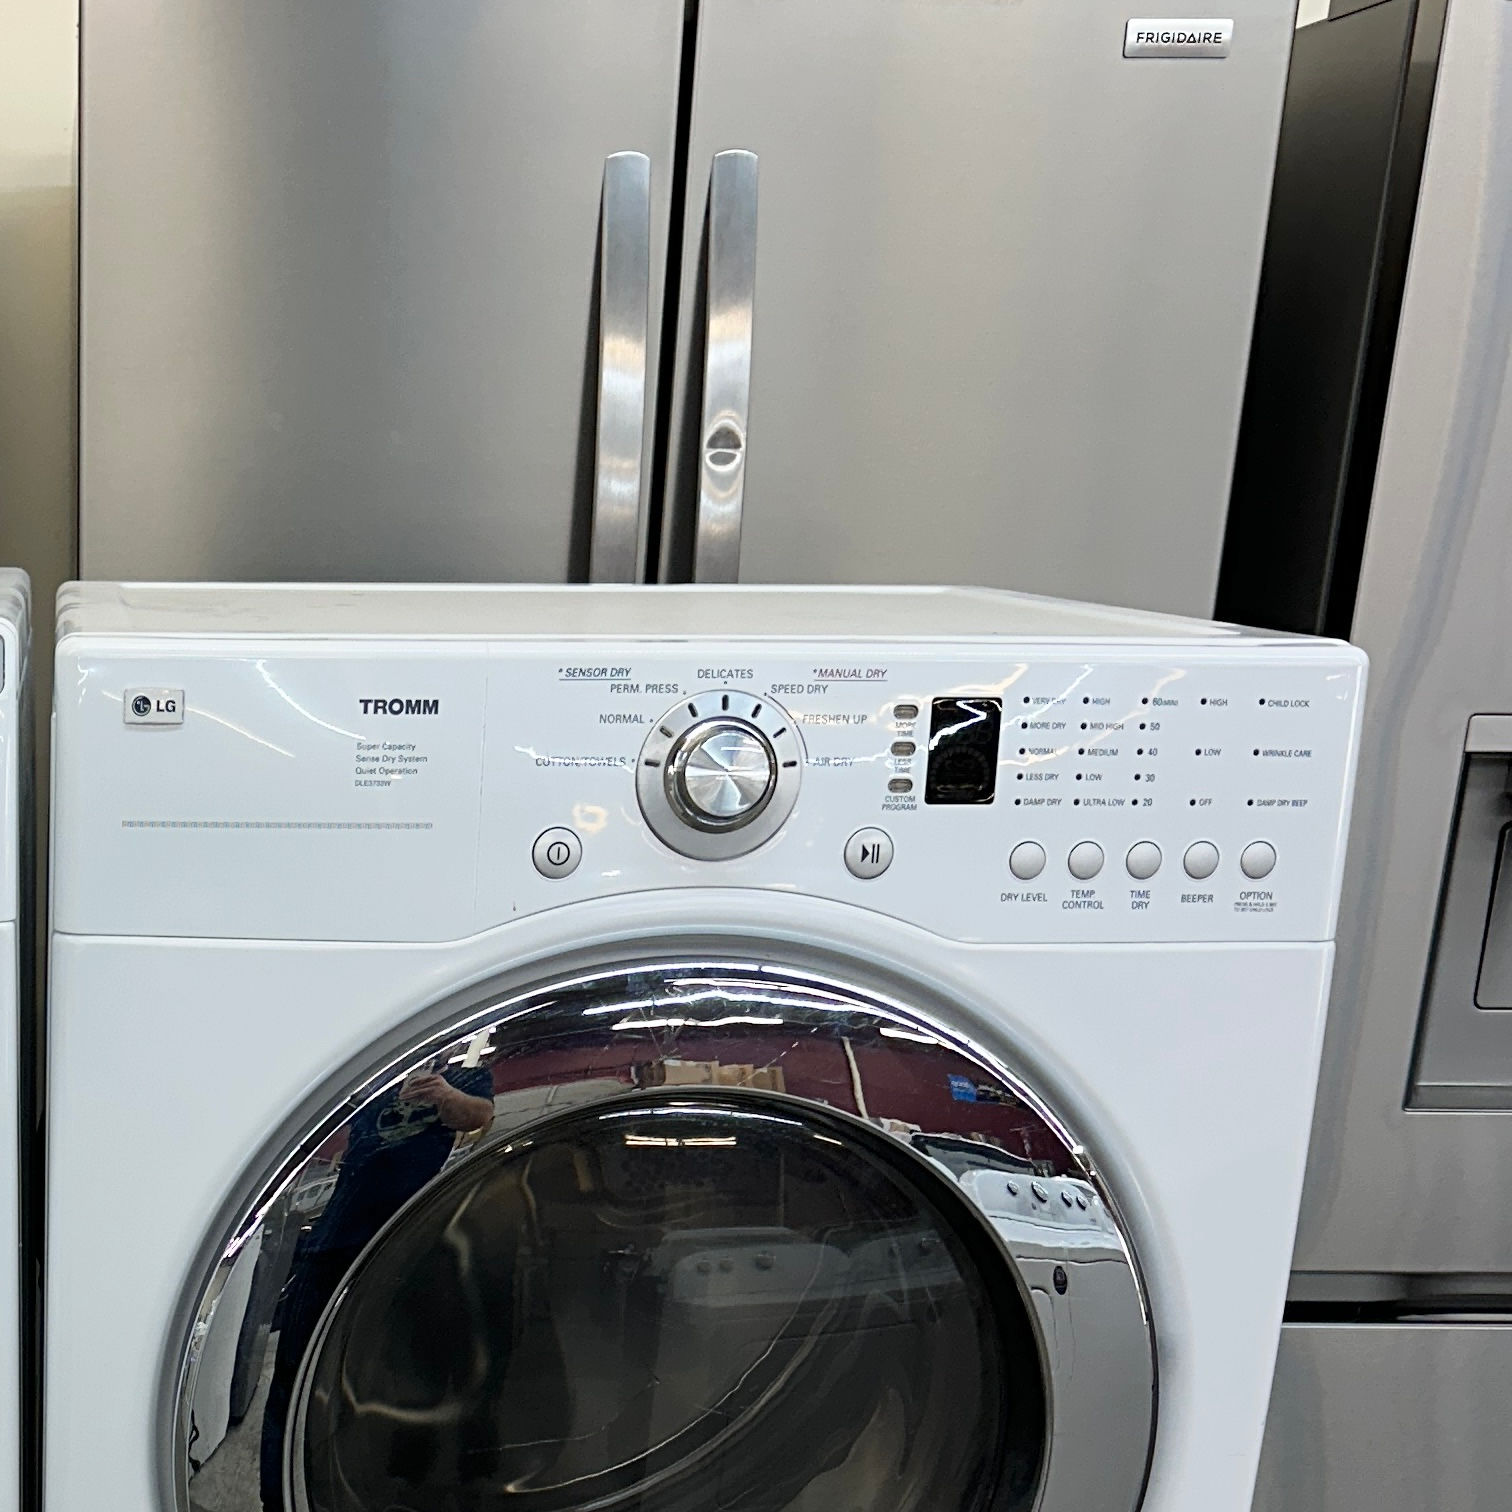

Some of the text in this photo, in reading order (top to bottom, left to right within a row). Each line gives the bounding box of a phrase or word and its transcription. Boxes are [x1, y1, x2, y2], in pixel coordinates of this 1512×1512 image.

[1136, 32, 1223, 44] FRIGIDAIRE
[564, 667, 632, 678] SENSOR DRY
[697, 669, 754, 679] DELICATES
[817, 668, 888, 679] MANUAL DRY
[645, 684, 679, 694] PRESS
[771, 684, 829, 694] SPEED DRY
[1092, 697, 1111, 705] HIGH
[1209, 699, 1228, 707] HIGH
[1268, 700, 1310, 708] CHILD LOCK
[156, 700, 177, 713] LG
[359, 699, 440, 715] TROMM
[599, 714, 645, 724] NORMAL
[802, 714, 868, 725] FRESHEN UP
[1030, 721, 1067, 729] MORE DRY
[1106, 723, 1124, 731] HIGH
[1150, 722, 1161, 731] 50
[356, 741, 417, 751] Super Capacity
[1087, 748, 1119, 756] MEDIUM
[1148, 748, 1158, 756] 40
[1204, 748, 1222, 757] LOW
[1262, 750, 1312, 758] WRINKLE CARE
[355, 754, 428, 764] Sense Dry System
[355, 766, 419, 776] Quiet Operation
[1025, 773, 1059, 781] LESS DRY
[1085, 773, 1102, 781] LOW
[1145, 773, 1155, 782] 30
[884, 795, 916, 803] CUSTOM
[1046, 798, 1062, 806] DRY
[1083, 798, 1126, 806] ULTRA LOW
[1143, 798, 1153, 807] 20
[1199, 799, 1213, 807] OFF
[881, 803, 918, 811] PROGRAM
[1000, 892, 1048, 902] DRY LEVEL
[1070, 889, 1096, 899] TEMP
[1130, 889, 1151, 899] TIME
[1181, 893, 1214, 903] BEEPER
[1239, 891, 1273, 901] OPTION
[1061, 900, 1104, 910] CONTROL
[1131, 900, 1151, 910] DRY
